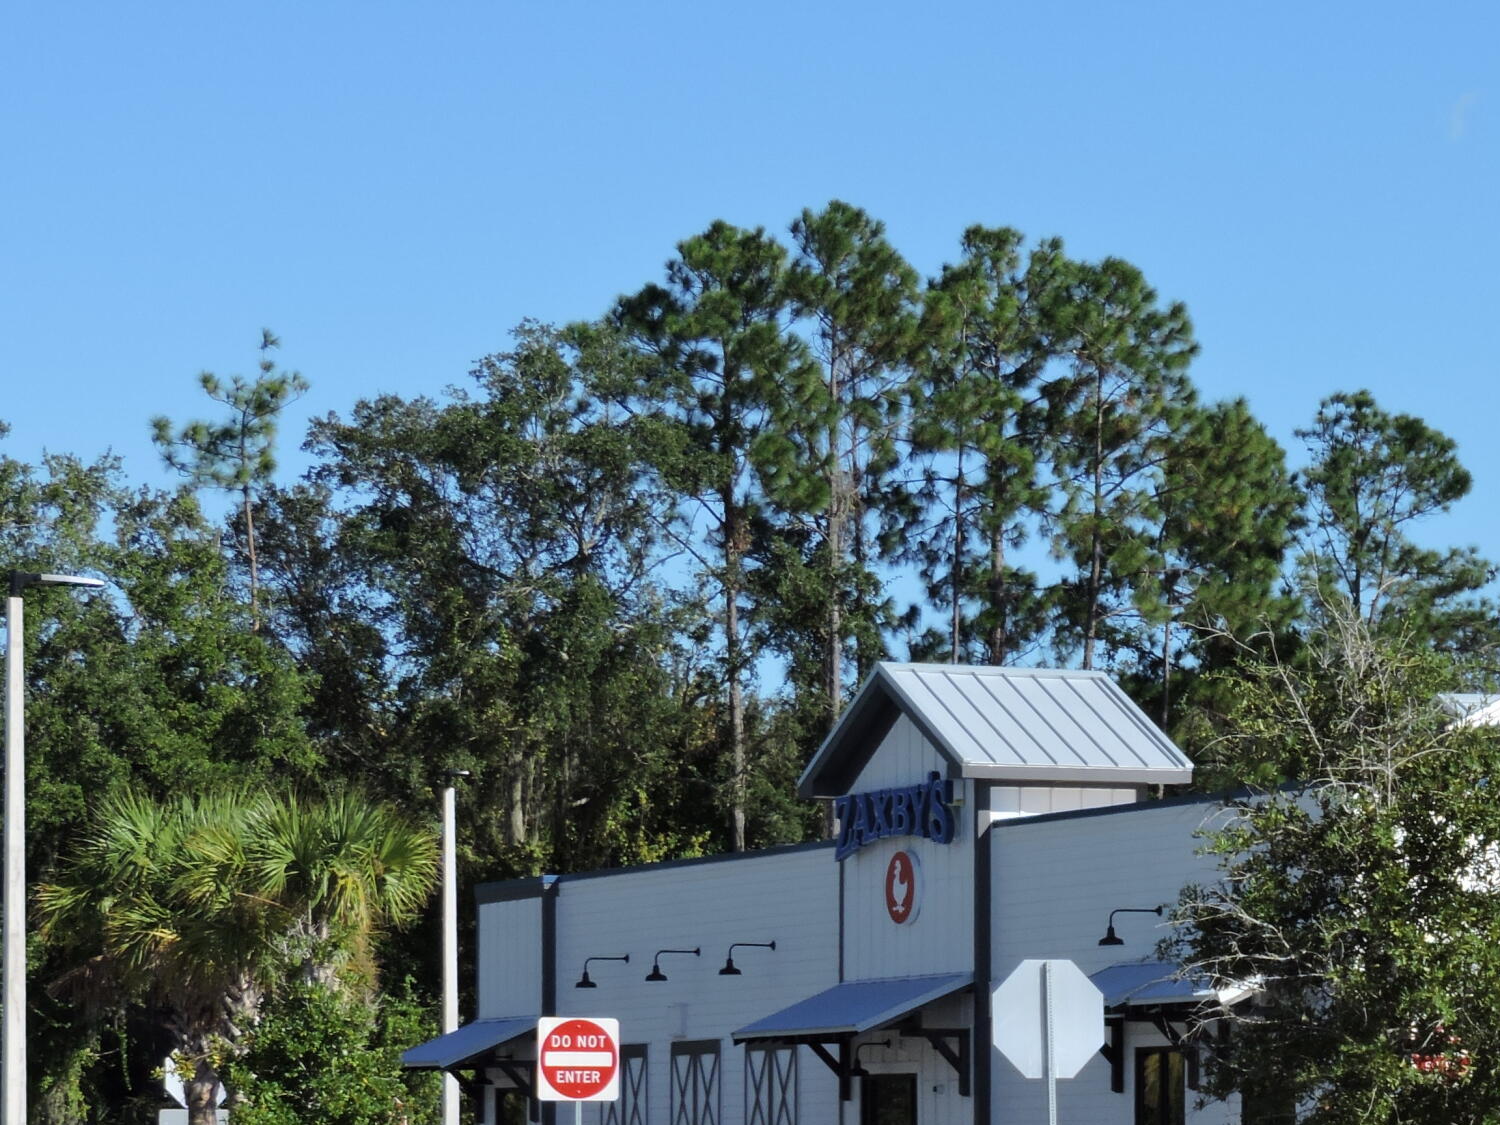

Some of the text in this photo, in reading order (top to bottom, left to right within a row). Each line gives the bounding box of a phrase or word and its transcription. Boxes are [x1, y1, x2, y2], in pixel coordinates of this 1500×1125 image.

[835, 771, 954, 861] ZAXBY'S
[551, 1035, 606, 1048] DO NOT
[556, 1070, 600, 1084] ENTER
